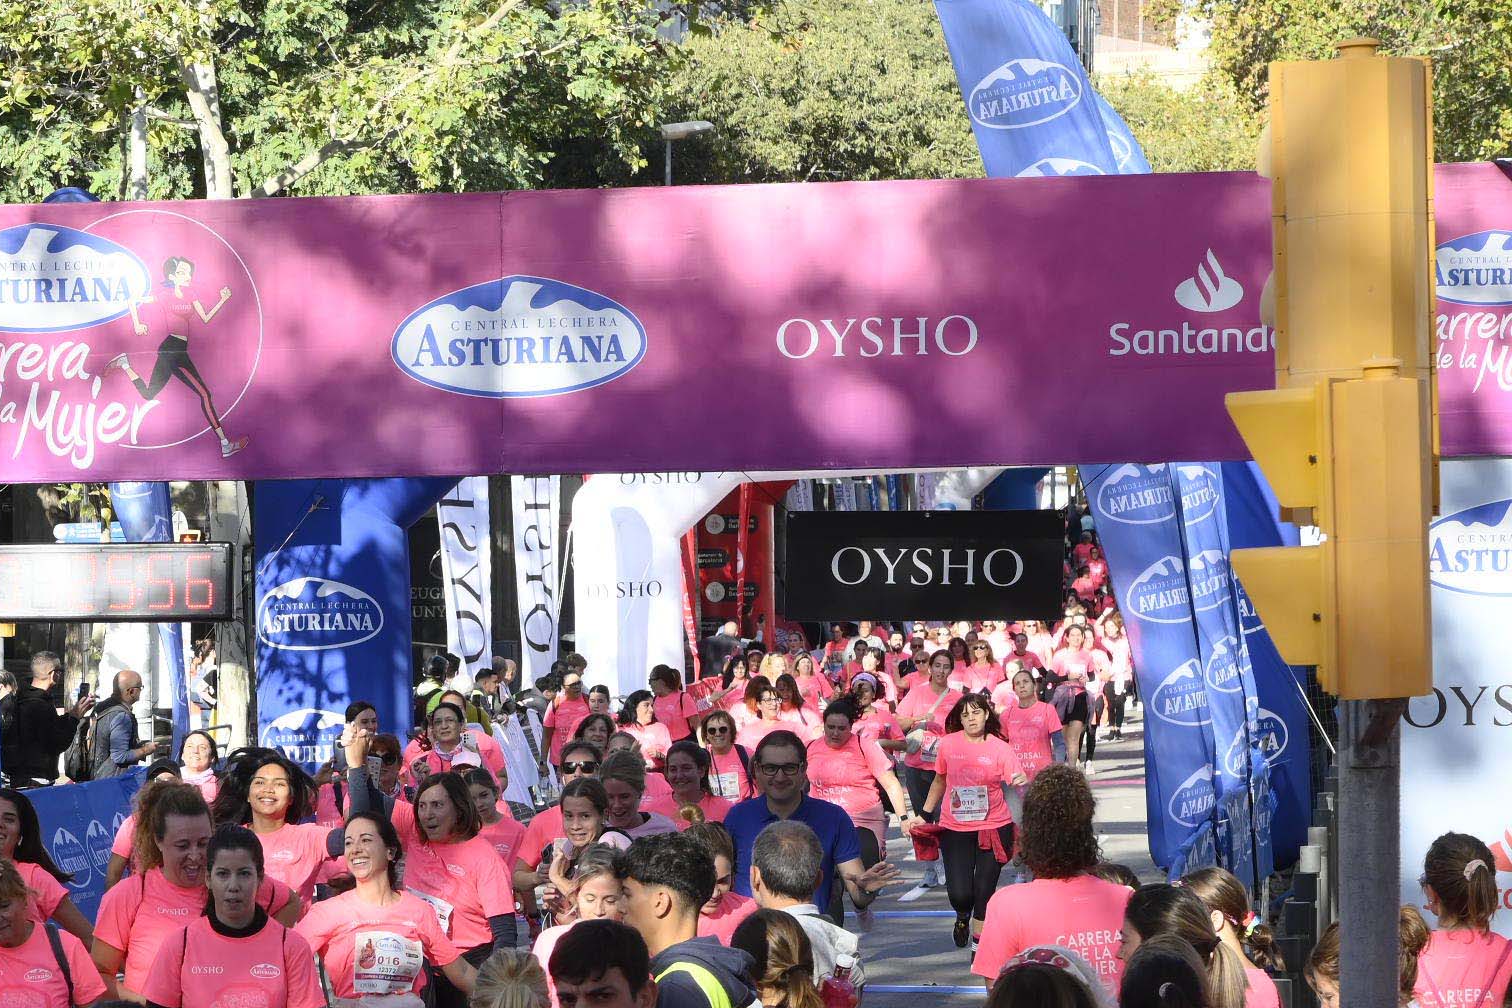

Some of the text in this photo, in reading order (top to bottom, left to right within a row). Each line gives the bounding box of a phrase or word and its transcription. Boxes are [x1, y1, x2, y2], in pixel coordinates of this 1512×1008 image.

[450, 316, 619, 333] CENTRAL LECHERA
[777, 314, 979, 360] OYSHO
[1109, 321, 1278, 357] Santand
[412, 322, 627, 368] ASTURIANA
[12, 381, 160, 470] Mujer
[830, 545, 1024, 587] OYSHO
[260, 605, 375, 634] ASTURIANA
[275, 600, 370, 611] CENTRAL LECHERA
[191, 966, 224, 975] OYSHO
[377, 956, 400, 966] 016
